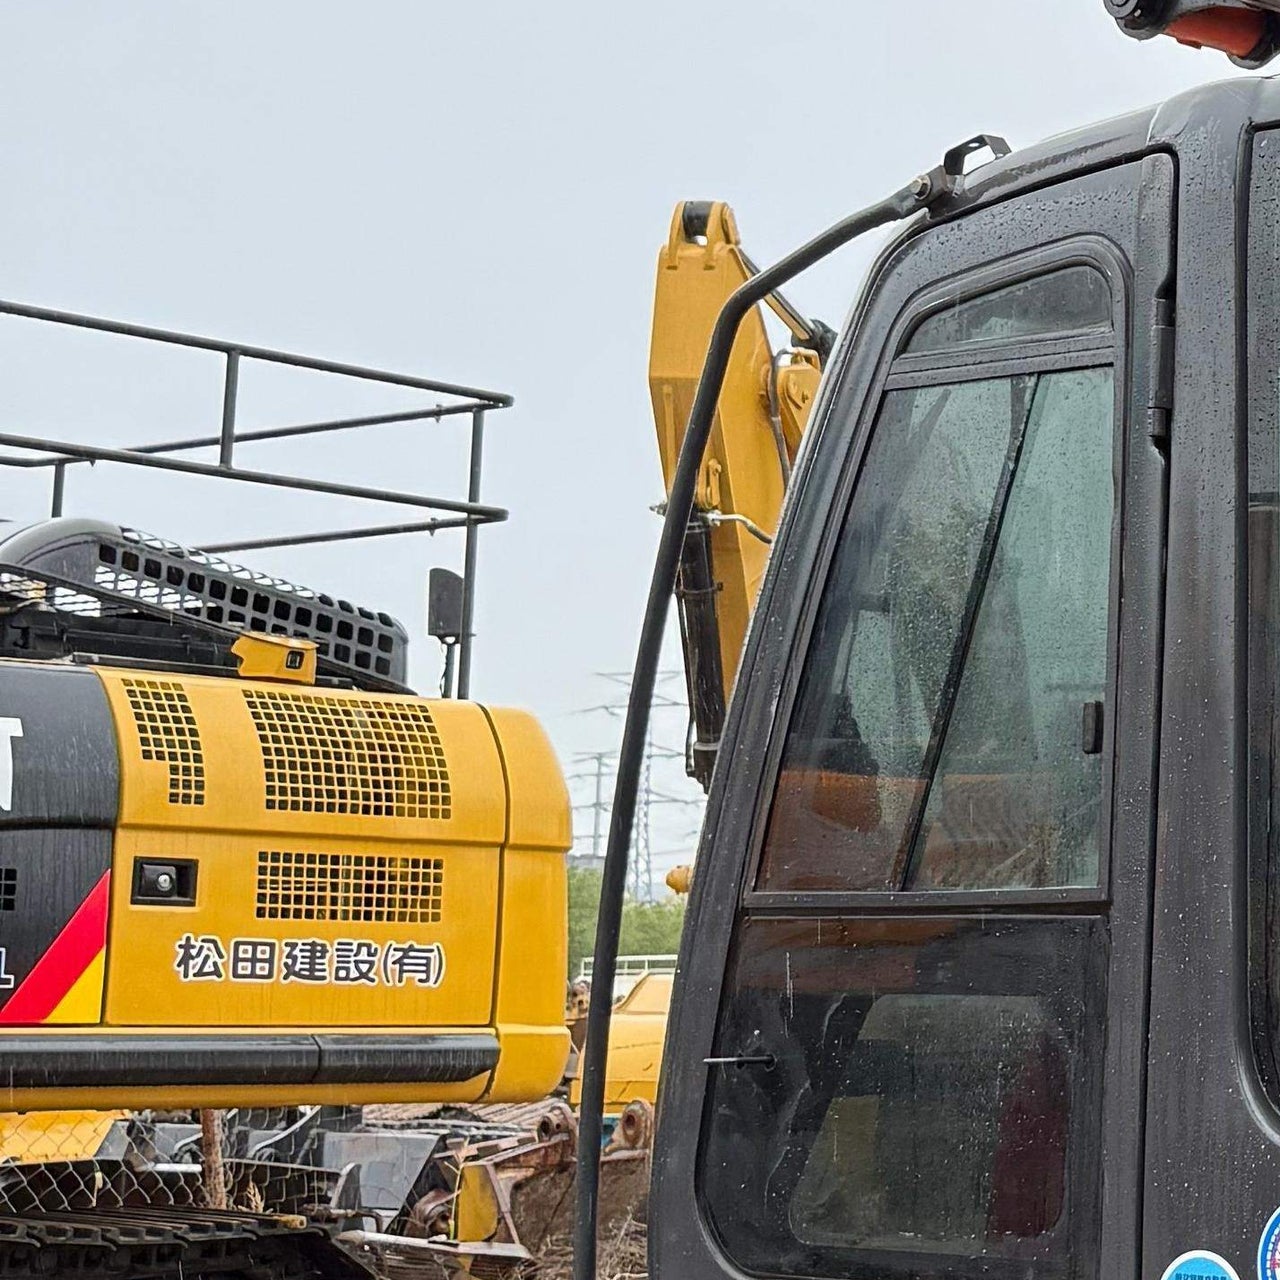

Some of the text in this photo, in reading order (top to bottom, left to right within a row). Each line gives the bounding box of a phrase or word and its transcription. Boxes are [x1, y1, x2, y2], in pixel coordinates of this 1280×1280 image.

[176, 934, 445, 986] 松田建設(有)
